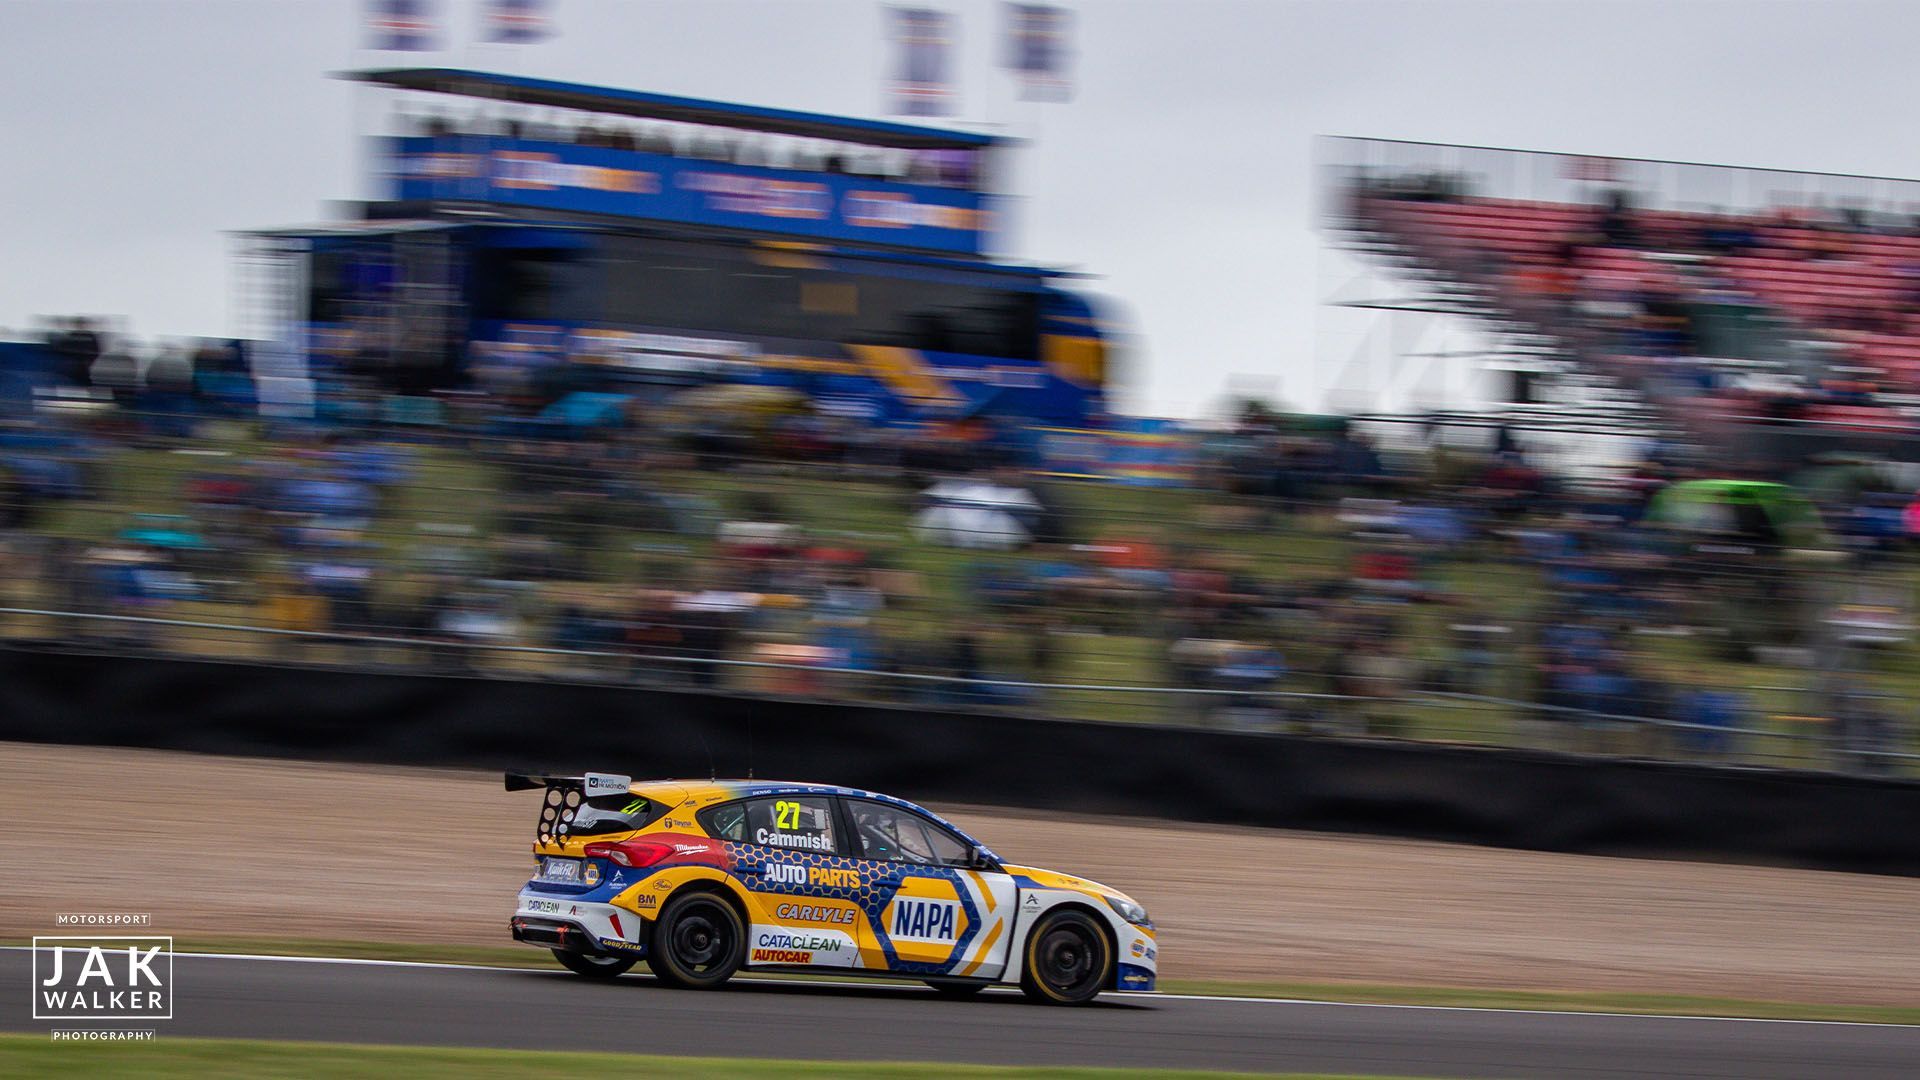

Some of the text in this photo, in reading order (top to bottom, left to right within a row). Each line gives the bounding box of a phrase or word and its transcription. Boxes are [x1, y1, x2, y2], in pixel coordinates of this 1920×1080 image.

[620, 799, 648, 814] 27
[775, 801, 800, 830] 27
[756, 828, 831, 850] Cammish
[764, 863, 861, 889] AUTO PARTS
[528, 900, 560, 912] CATACLEAN
[638, 894, 656, 904] BM
[776, 903, 856, 924] CARLYLE
[895, 901, 953, 940] NAPA
[602, 940, 642, 951] GOODYEAR
[759, 934, 841, 952] CATACLEAN
[754, 950, 810, 963] AUTOCAR
